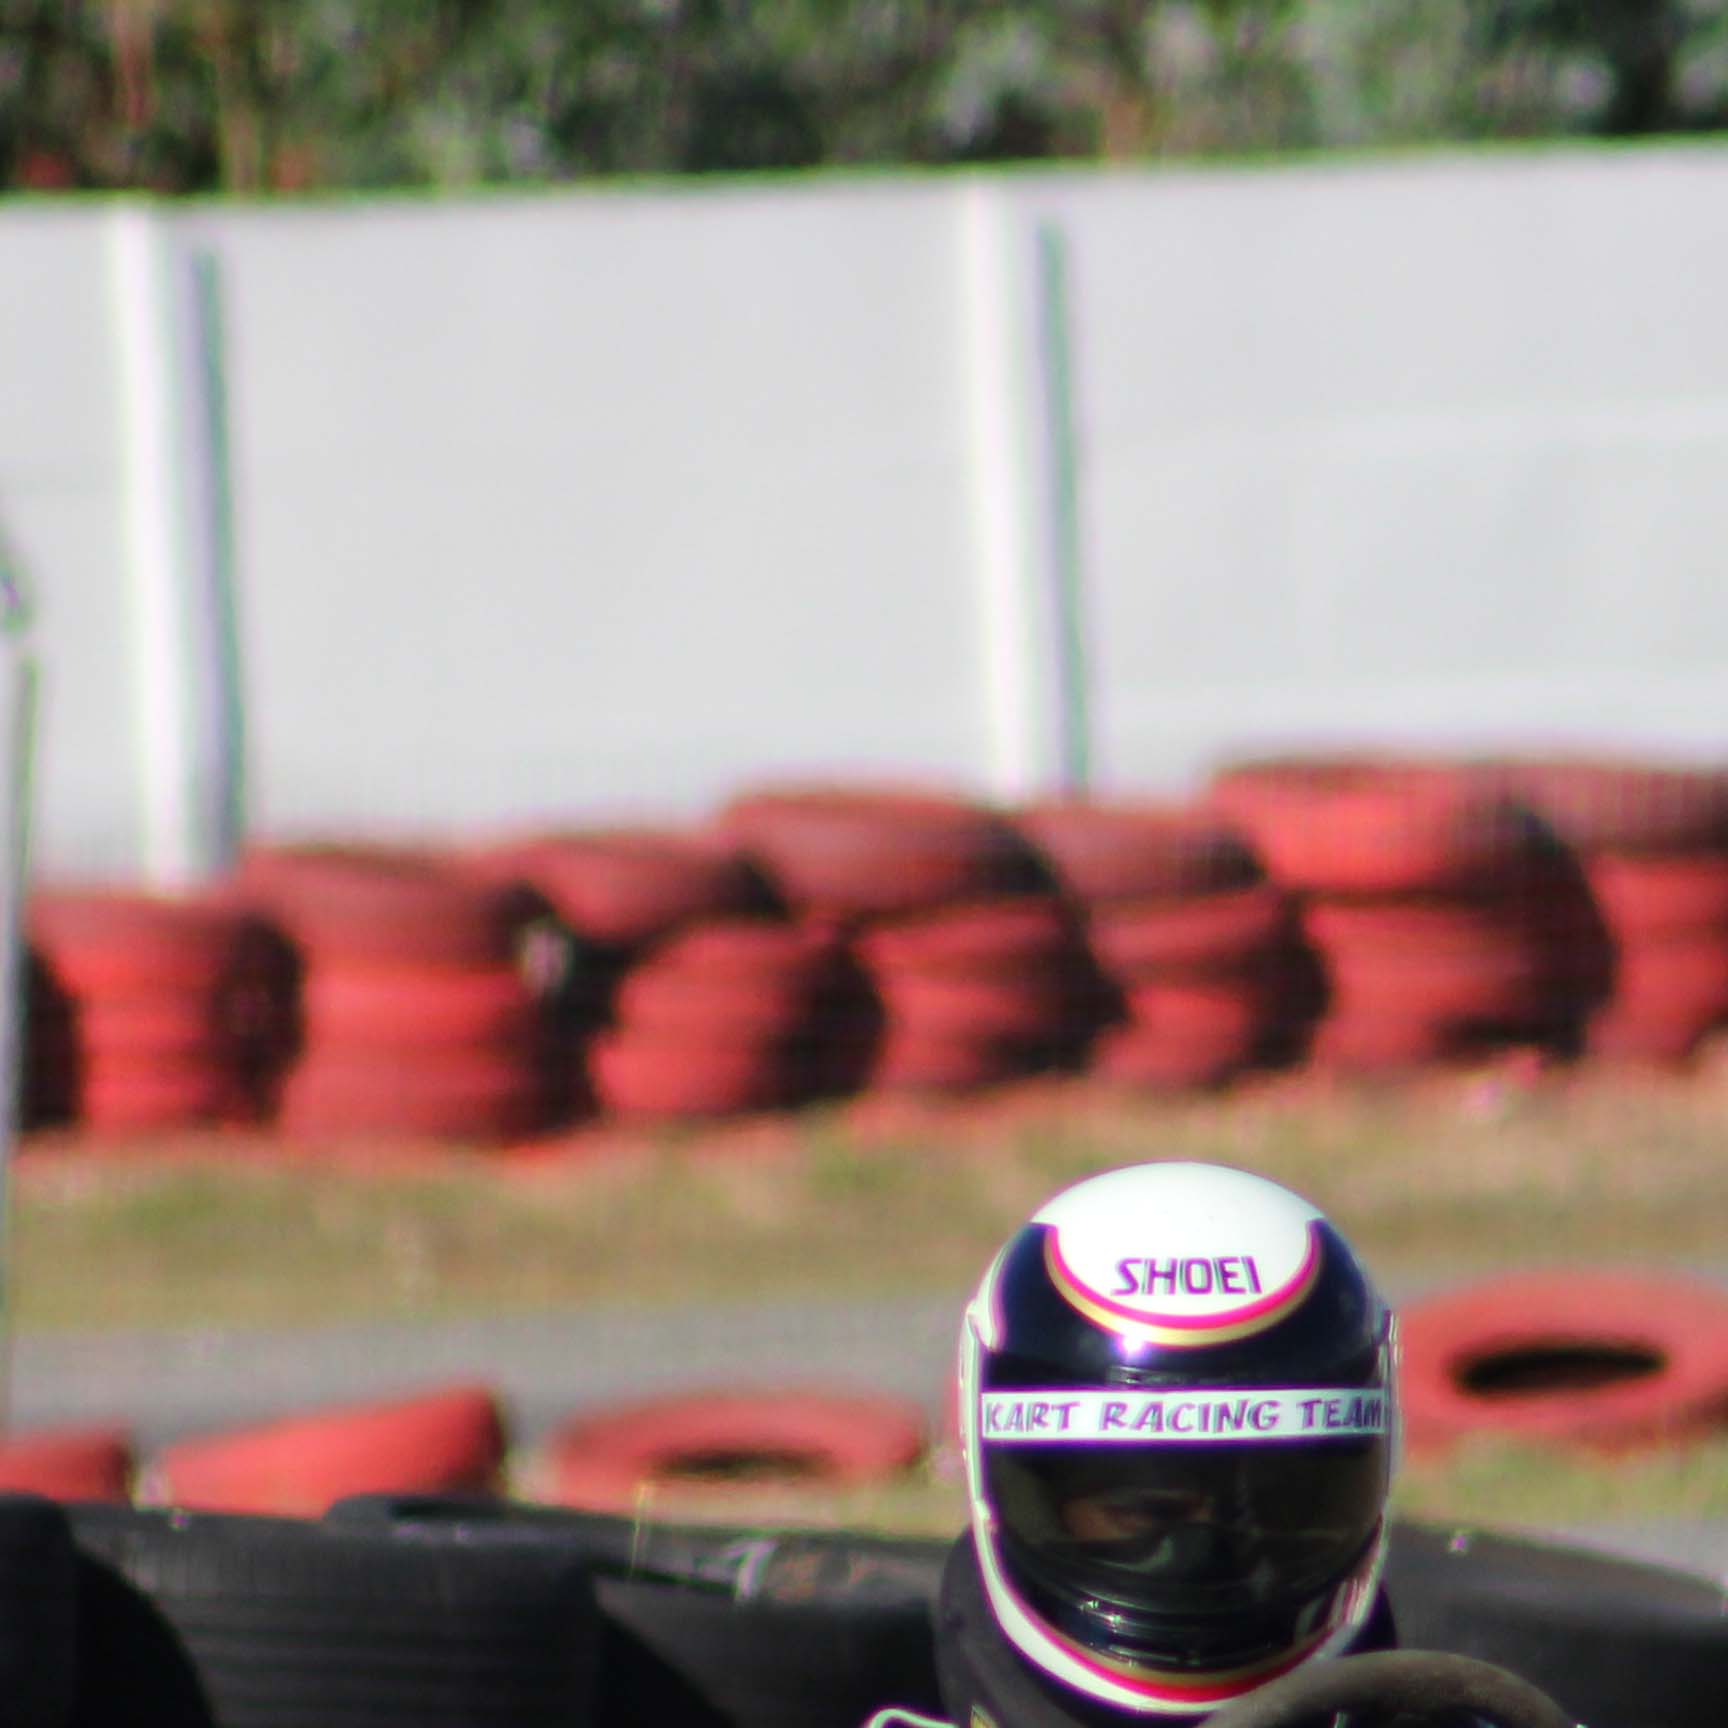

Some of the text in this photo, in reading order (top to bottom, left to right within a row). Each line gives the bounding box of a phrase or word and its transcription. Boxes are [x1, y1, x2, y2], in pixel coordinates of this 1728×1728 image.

[1111, 1256, 1262, 1297] SHOEI
[985, 1396, 1384, 1435] KART RACING TEAM
